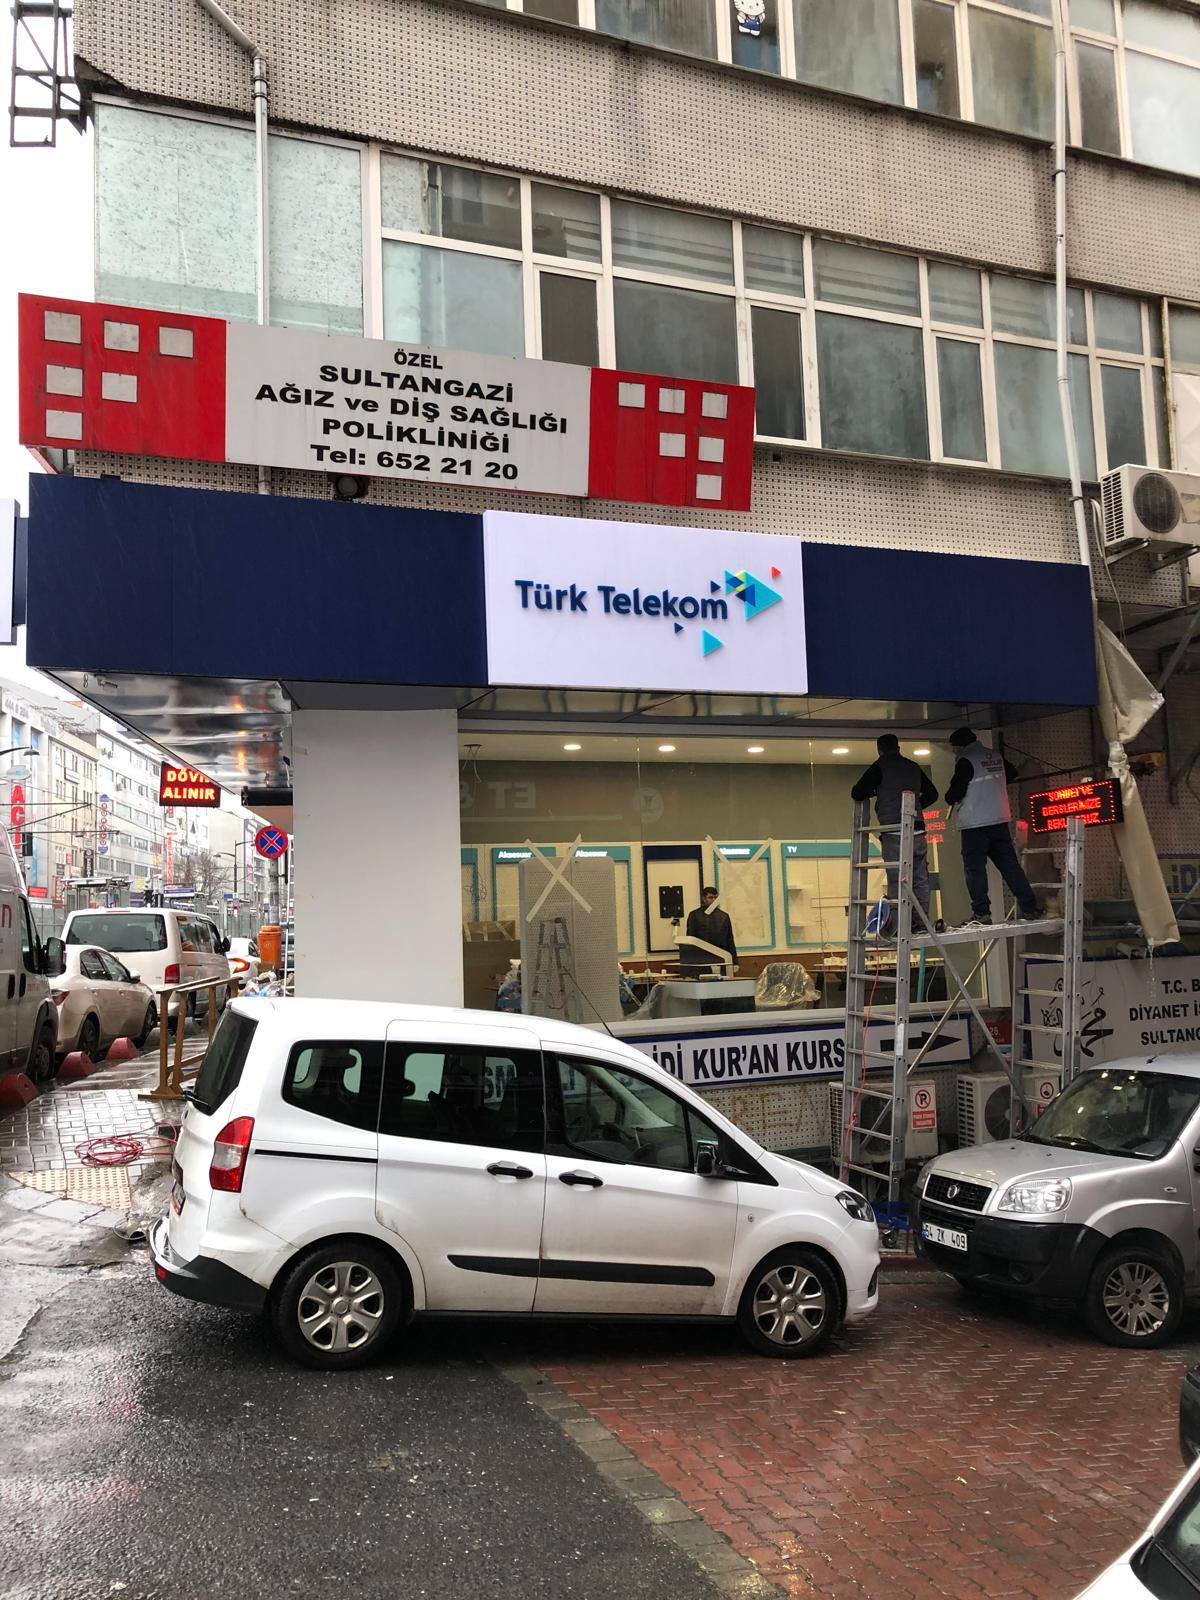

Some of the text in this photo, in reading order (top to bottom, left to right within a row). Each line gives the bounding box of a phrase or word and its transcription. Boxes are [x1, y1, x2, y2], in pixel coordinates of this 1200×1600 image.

[394, 349, 443, 370] ÖZEL
[319, 365, 514, 403] SULTANGAZİ
[255, 382, 567, 434] AĞIZ ve DİŞ SAĞLIĞI
[322, 418, 510, 454] POLİKLİNİĞİ
[310, 444, 519, 481] Tel: 652 21 20
[514, 579, 729, 620] Türk Telekom
[163, 787, 216, 800] ALINIR
[1161, 979, 1187, 994] T.C.
[1129, 999, 1200, 1021] DİYANET İ
[693, 1043, 779, 1081] KUR'AN
[786, 1038, 846, 1073] KURS
[951, 1232, 966, 1249] 409
